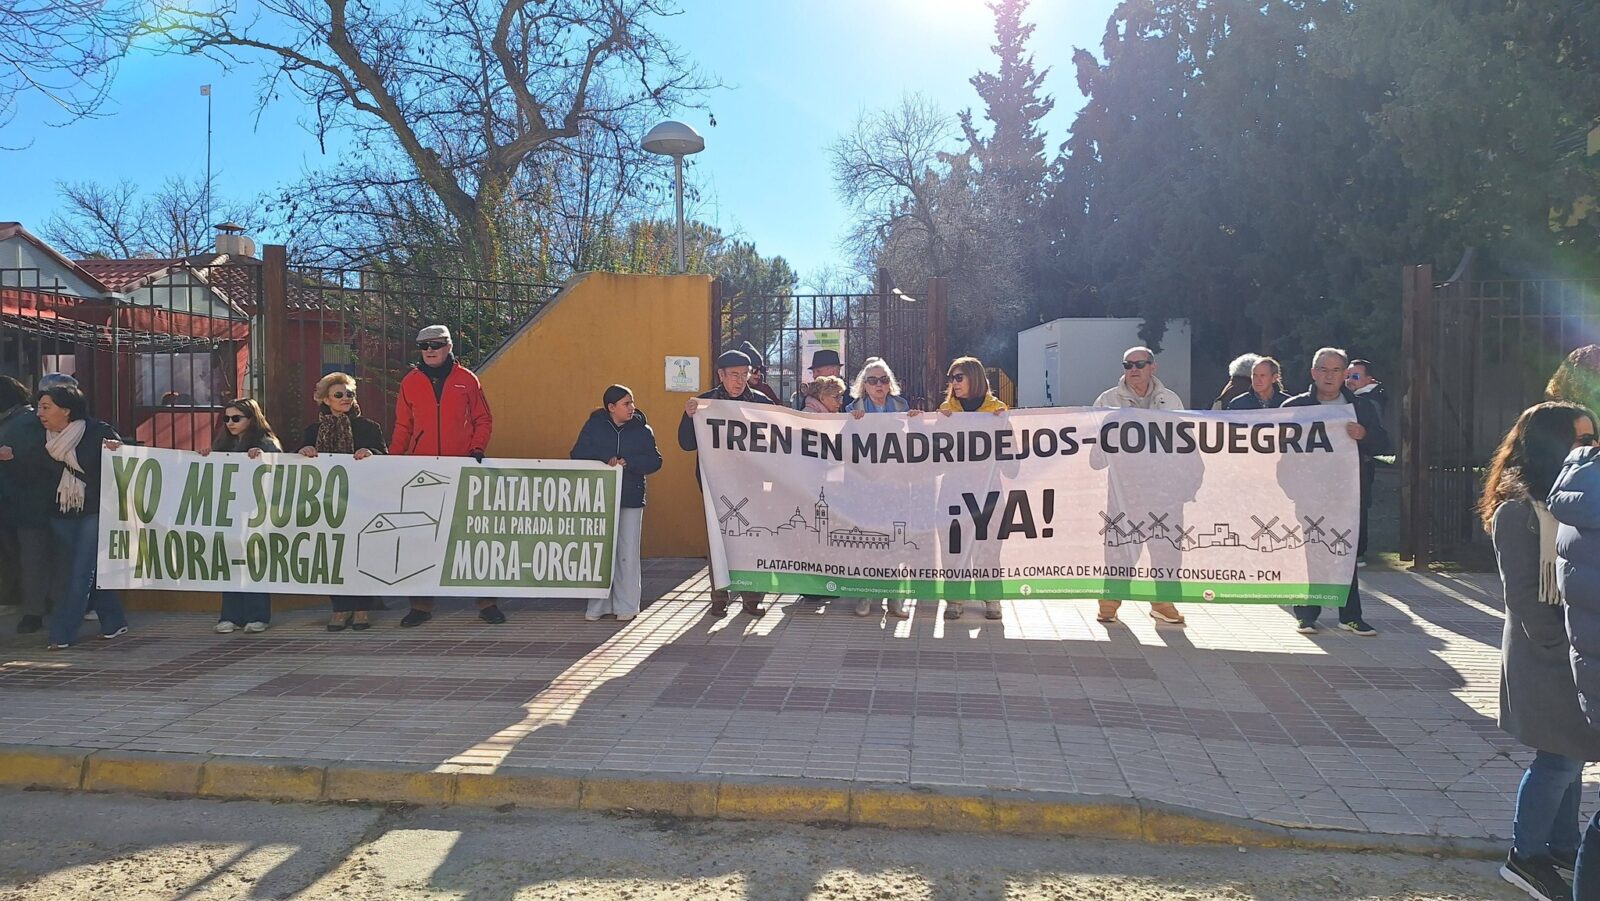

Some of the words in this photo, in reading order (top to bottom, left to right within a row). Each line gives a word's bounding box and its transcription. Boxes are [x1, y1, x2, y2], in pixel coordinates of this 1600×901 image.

[706, 418, 792, 454] TREN
[801, 428, 843, 461] EN
[852, 421, 1334, 464] MADRIDEJOS-CONSUEGRA
[112, 455, 163, 524] YO
[174, 461, 240, 527] ME
[247, 463, 349, 529] SUBO
[467, 475, 606, 513] PLATAFORMA
[466, 516, 489, 535] POR
[494, 516, 506, 535] LA
[511, 516, 554, 536] PARADA
[558, 517, 575, 536] DEL
[580, 518, 606, 537] TREN
[949, 488, 1055, 554] ¡YA!
[108, 529, 130, 560] EN
[134, 528, 345, 585] MORA-ORGAZ
[451, 540, 603, 582] MORA-ORGAZ
[756, 558, 823, 573] PLATAFORMA
[825, 564, 845, 576] POR
[848, 566, 861, 576] LA
[863, 566, 916, 578] CONEXIÓN
[919, 568, 989, 579] FERROVIARIA
[992, 567, 1005, 578] DE
[1008, 566, 1021, 577] LA
[1023, 565, 1074, 577] COMARCA
[1076, 565, 1090, 576] DE
[1093, 565, 1164, 579] MADRIDEJOS
[1166, 568, 1174, 579] Y
[1176, 568, 1247, 581] CONSUEGRA
[1257, 570, 1281, 581] PCM
